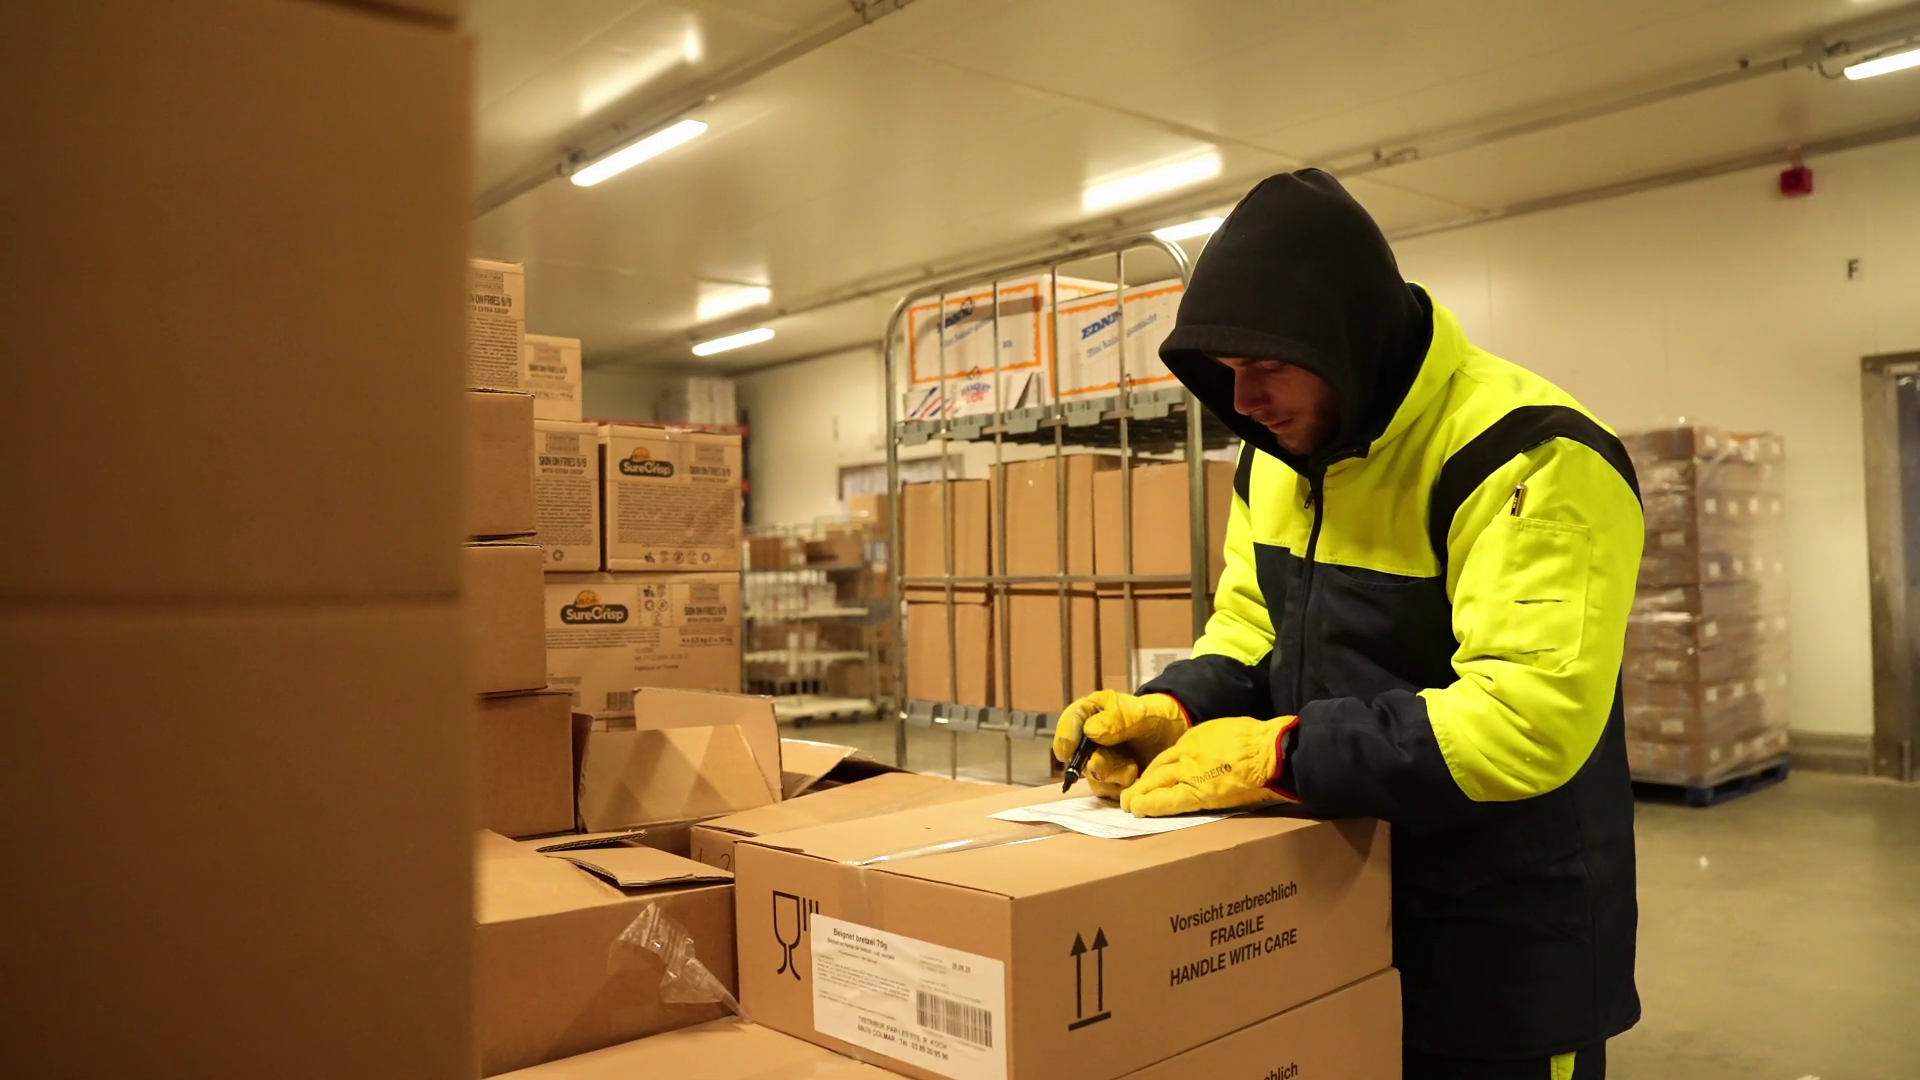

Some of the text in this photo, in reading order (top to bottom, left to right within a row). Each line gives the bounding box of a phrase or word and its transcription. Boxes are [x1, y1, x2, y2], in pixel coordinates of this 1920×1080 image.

[1847, 258, 1860, 280] F
[538, 455, 551, 466] SKIN
[561, 457, 576, 467] FRIES
[623, 461, 671, 476] SureCrisp
[566, 606, 624, 622] SureCrisp
[1190, 766, 1225, 785] SINGER
[1170, 881, 1297, 933] Vorsicht zerbrechlich
[833, 927, 888, 951] Beignet bretzel 70g
[1210, 915, 1264, 947] FRAGILE
[1170, 928, 1297, 987] HANDLE WITH CARE
[872, 1030, 896, 1041] COLMAR
[886, 1024, 898, 1033] PAR
